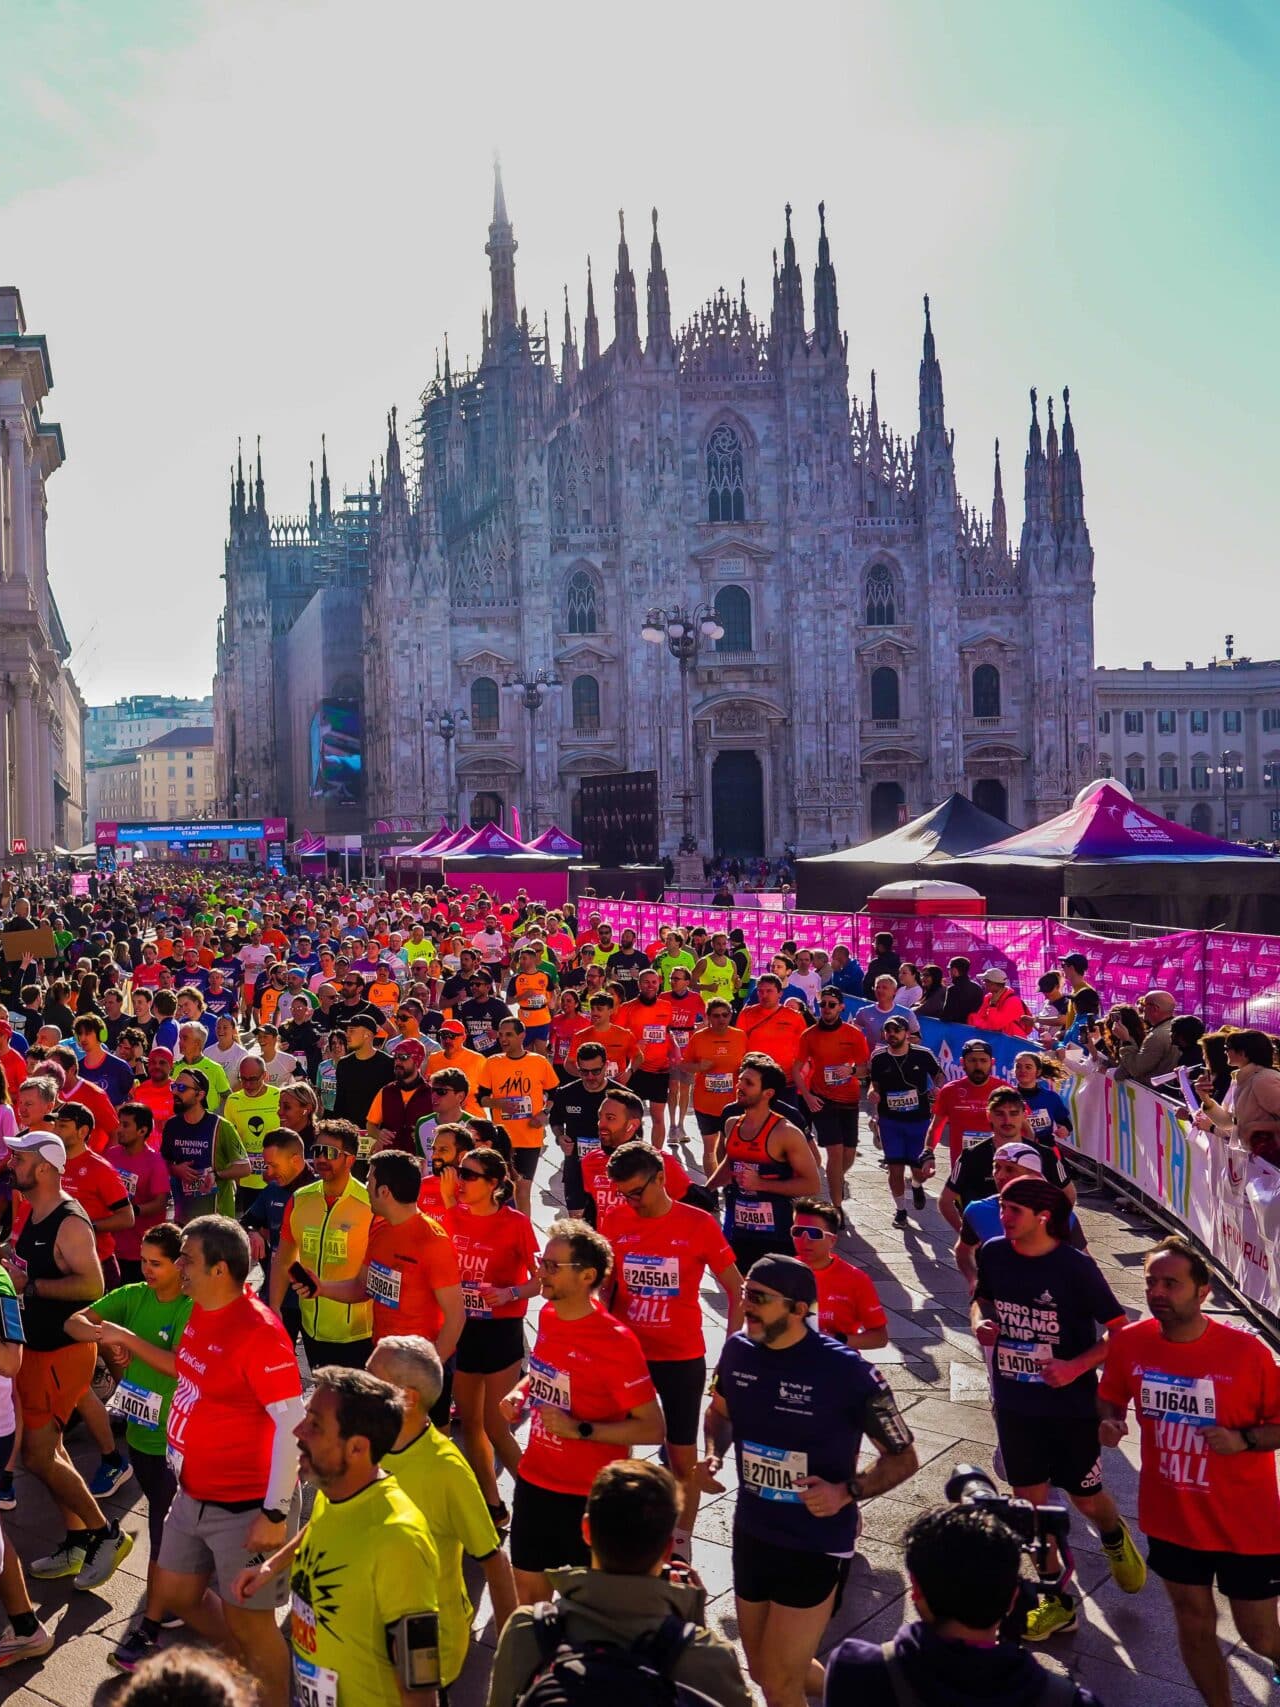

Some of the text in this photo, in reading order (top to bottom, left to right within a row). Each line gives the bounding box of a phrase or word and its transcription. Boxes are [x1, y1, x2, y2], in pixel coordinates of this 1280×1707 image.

[174, 1139, 209, 1149] RUNNING
[181, 1147, 202, 1155] TEAM
[740, 1211, 766, 1224] 1248A
[370, 1274, 393, 1299] 3988A
[631, 1269, 670, 1287] 2455A
[994, 1299, 1058, 1320] ORRO PER
[998, 1311, 1060, 1333] YNAMO
[1000, 1324, 1035, 1341] AMP
[529, 1376, 561, 1405] 2457A
[121, 1395, 150, 1420] 1407A
[1155, 1390, 1199, 1414] 1164A
[751, 1461, 793, 1490] 2701A
